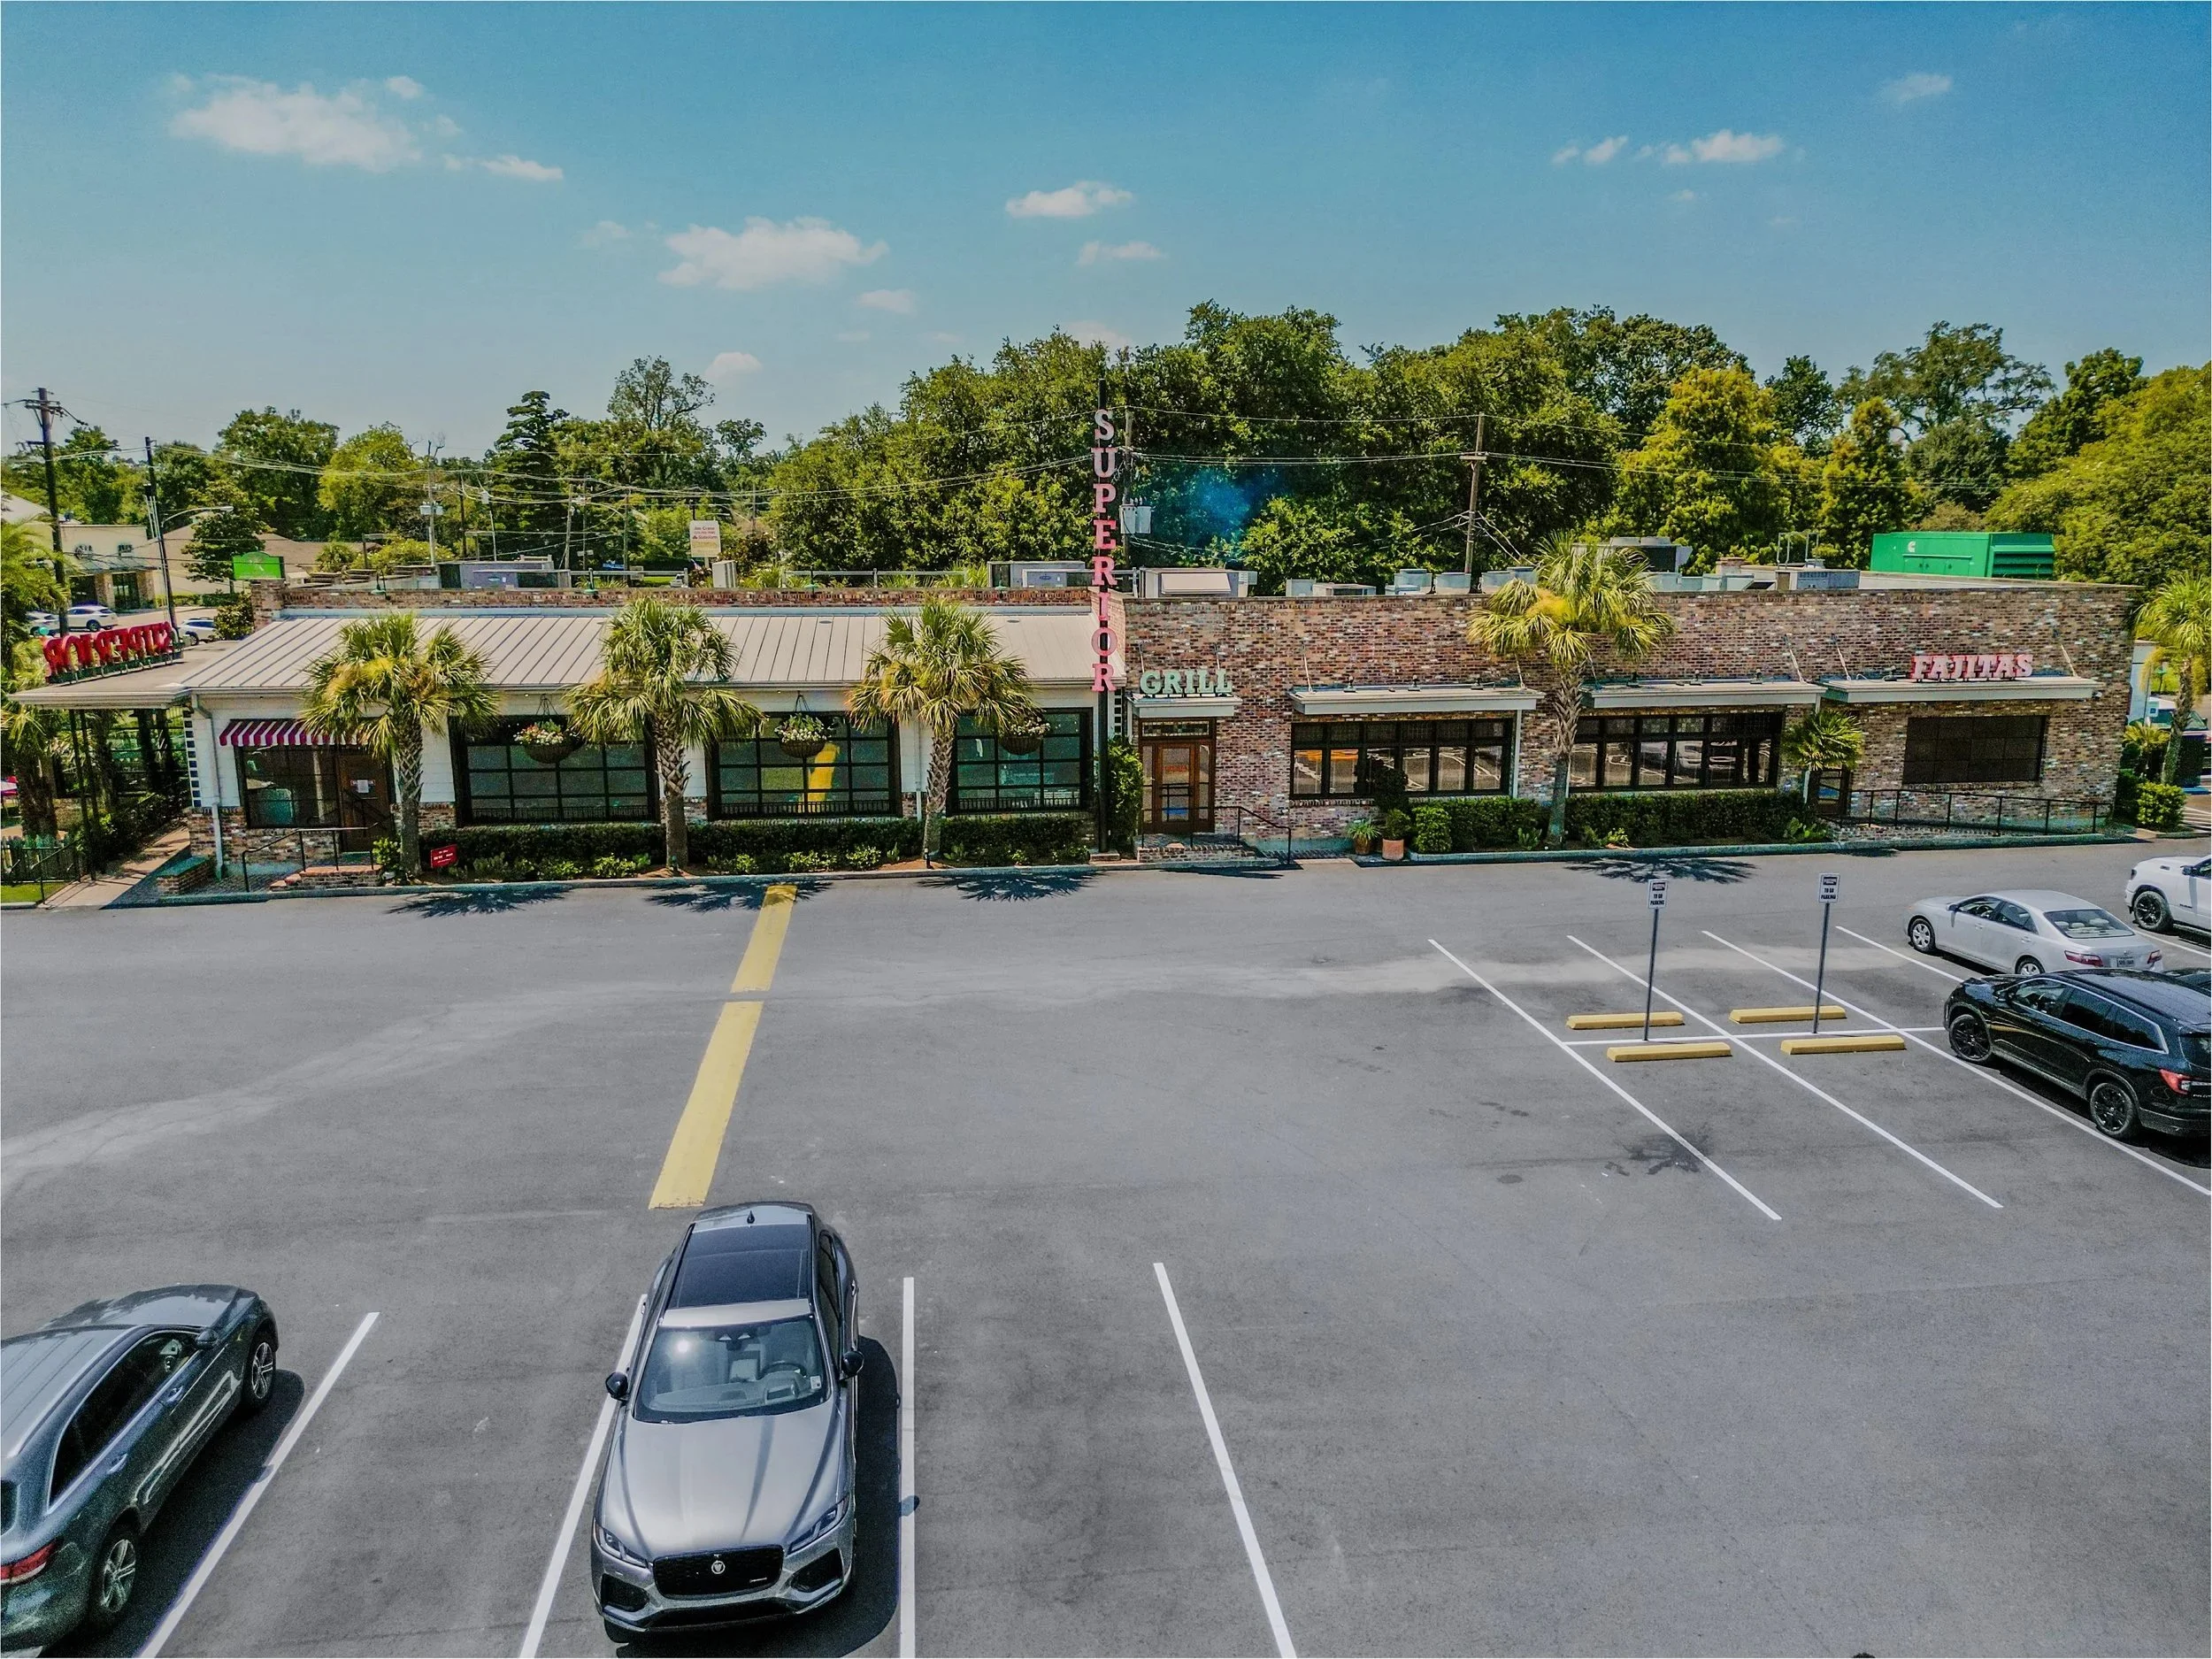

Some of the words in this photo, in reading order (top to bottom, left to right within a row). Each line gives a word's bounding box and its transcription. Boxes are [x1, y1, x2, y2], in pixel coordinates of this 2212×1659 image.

[1091, 408, 1118, 693] SUPERIOR
[1912, 654, 2033, 679] FAJITAS
[1140, 668, 1233, 695] GRILL
